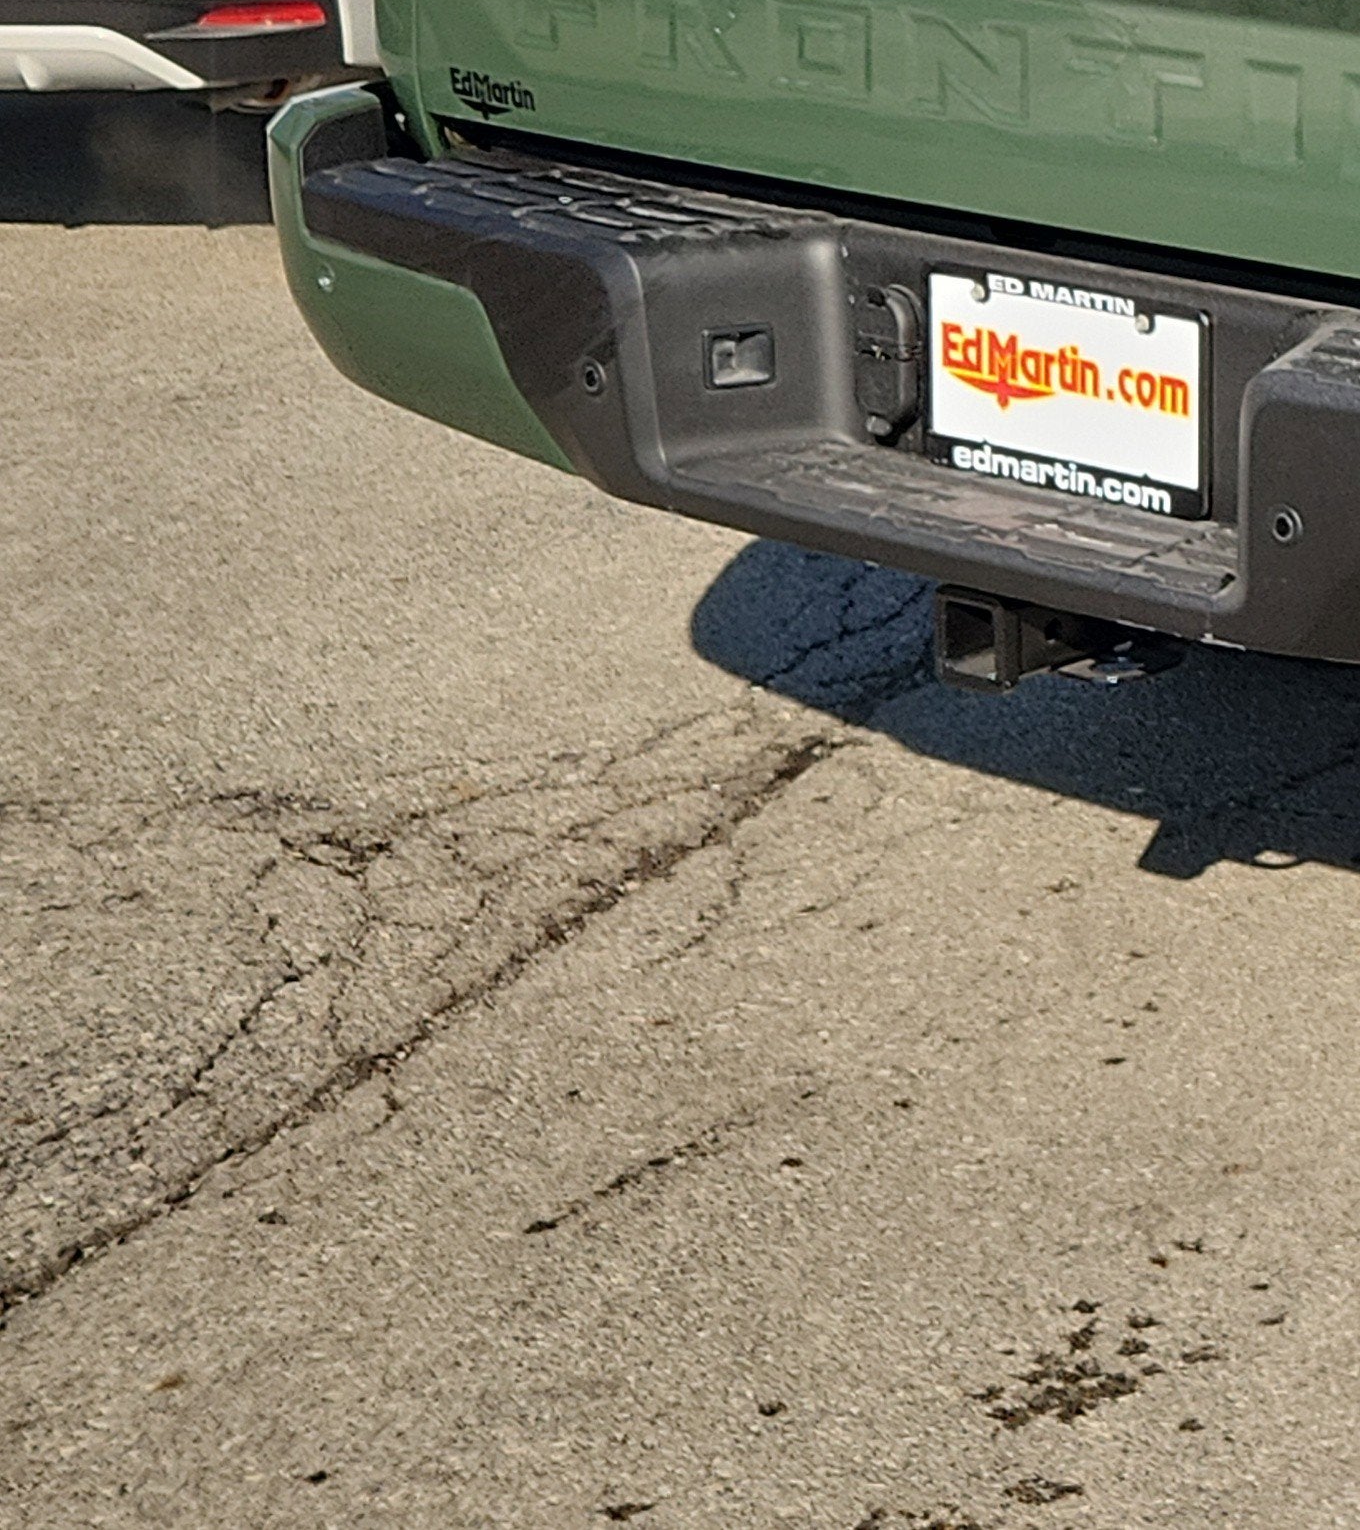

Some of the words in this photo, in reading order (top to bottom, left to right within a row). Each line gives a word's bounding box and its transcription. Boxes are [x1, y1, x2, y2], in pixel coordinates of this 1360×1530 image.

[449, 66, 536, 113] EdMartin
[986, 273, 1025, 296] ED
[1030, 282, 1136, 317] MARTIN
[952, 444, 1172, 515] edmartin.com
